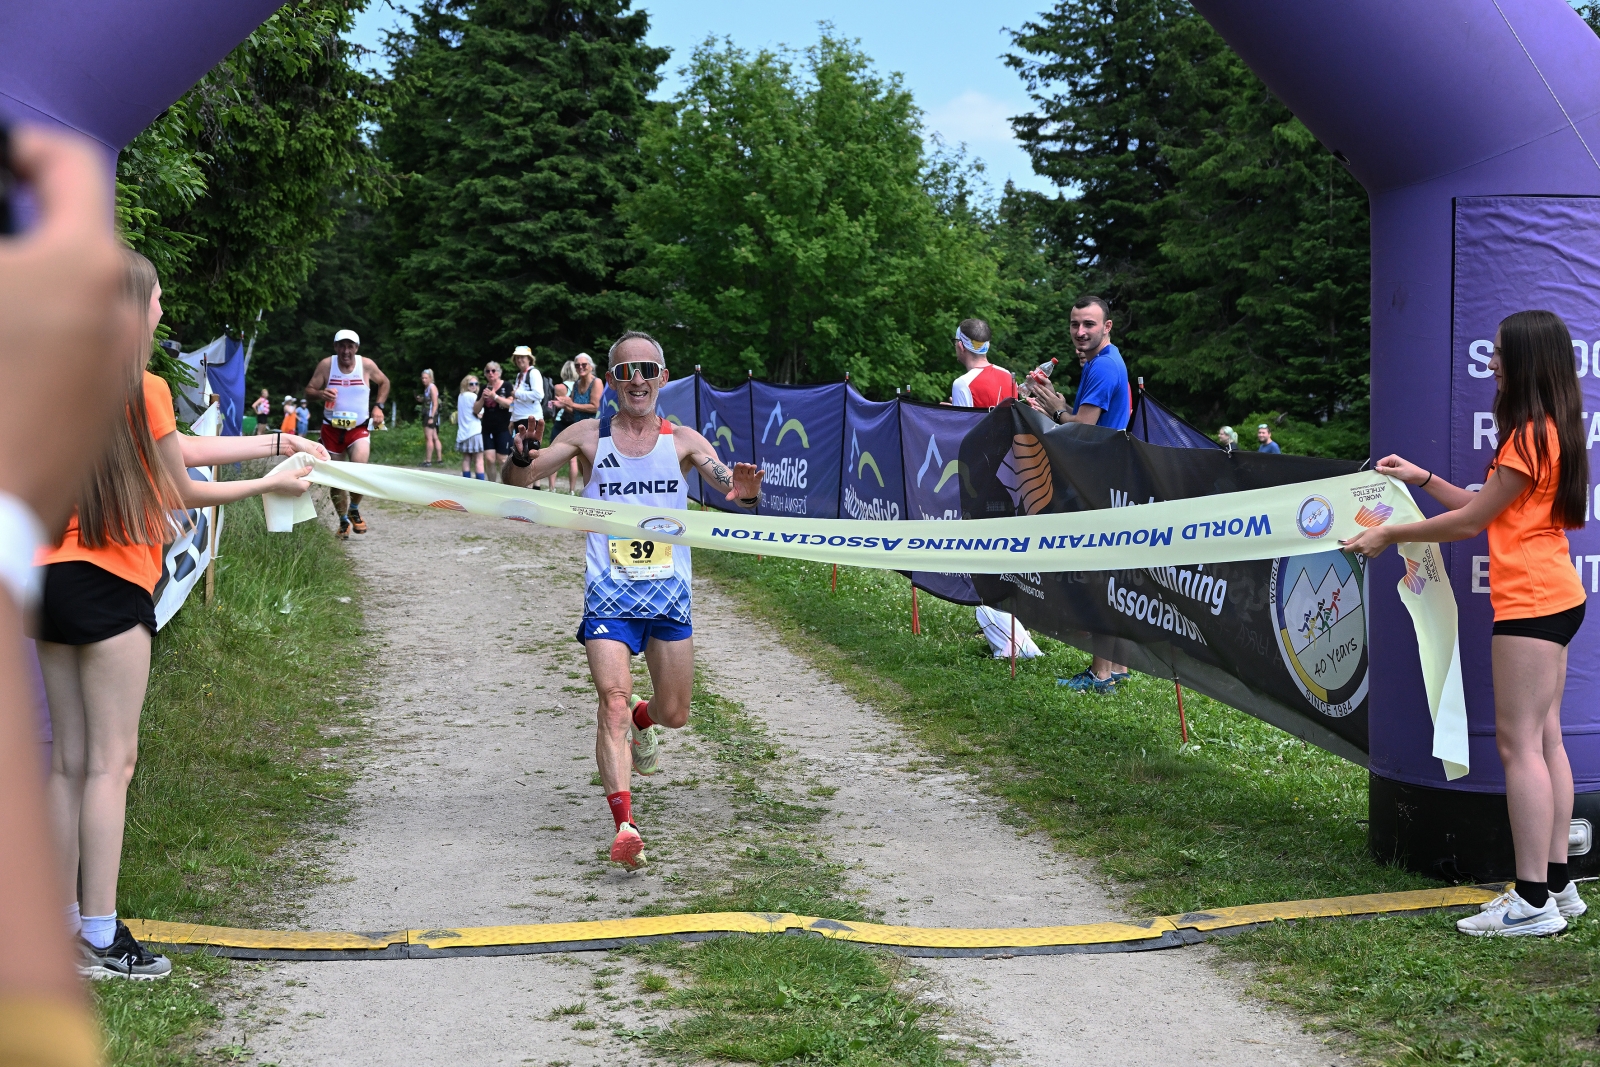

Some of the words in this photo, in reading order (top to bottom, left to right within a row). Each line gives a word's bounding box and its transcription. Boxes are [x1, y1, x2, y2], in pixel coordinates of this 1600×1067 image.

[599, 480, 679, 497] FRANCE
[1358, 493, 1383, 502] WORLD
[1181, 514, 1272, 539] WORLD
[711, 527, 904, 551] ASSOCIATION
[907, 536, 1031, 553] RUNNING
[1038, 526, 1174, 550] MOUNTAIN
[630, 540, 655, 559] 39
[1107, 576, 1208, 646] Association
[1314, 660, 1327, 678] 40
[1305, 689, 1332, 716] SINCE
[1333, 699, 1353, 717] 1984
